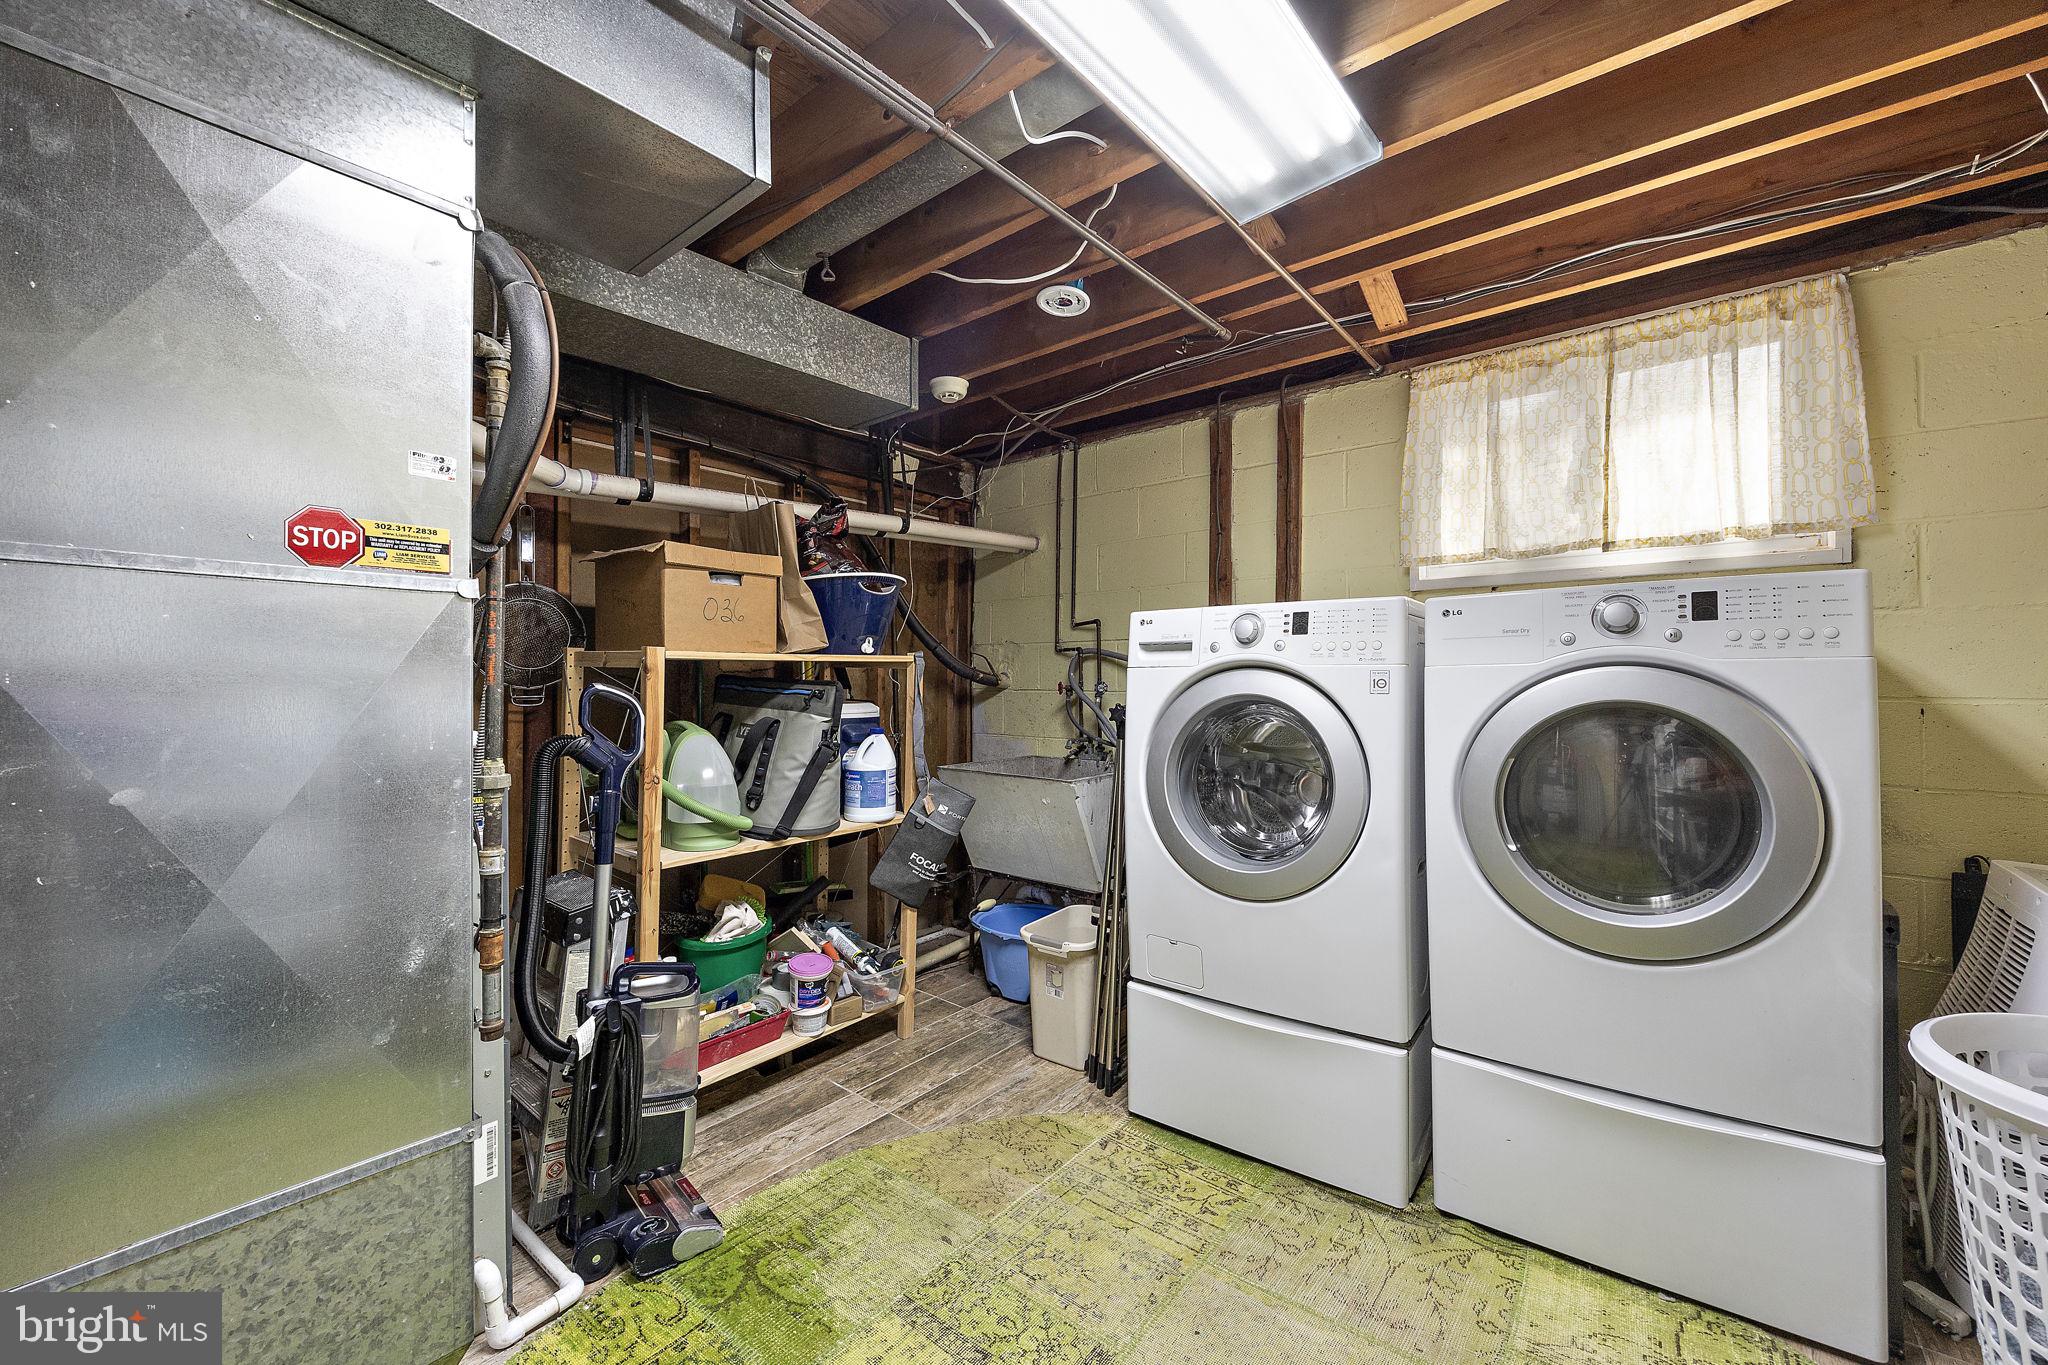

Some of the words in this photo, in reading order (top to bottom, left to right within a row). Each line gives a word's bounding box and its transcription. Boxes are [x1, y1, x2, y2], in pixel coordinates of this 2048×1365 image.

[292, 525, 356, 550] STOP
[374, 522, 438, 536] 302.317.2838
[703, 598, 744, 624] 036
[1373, 678, 1387, 689] 10
[910, 852, 938, 871] FOCAL
